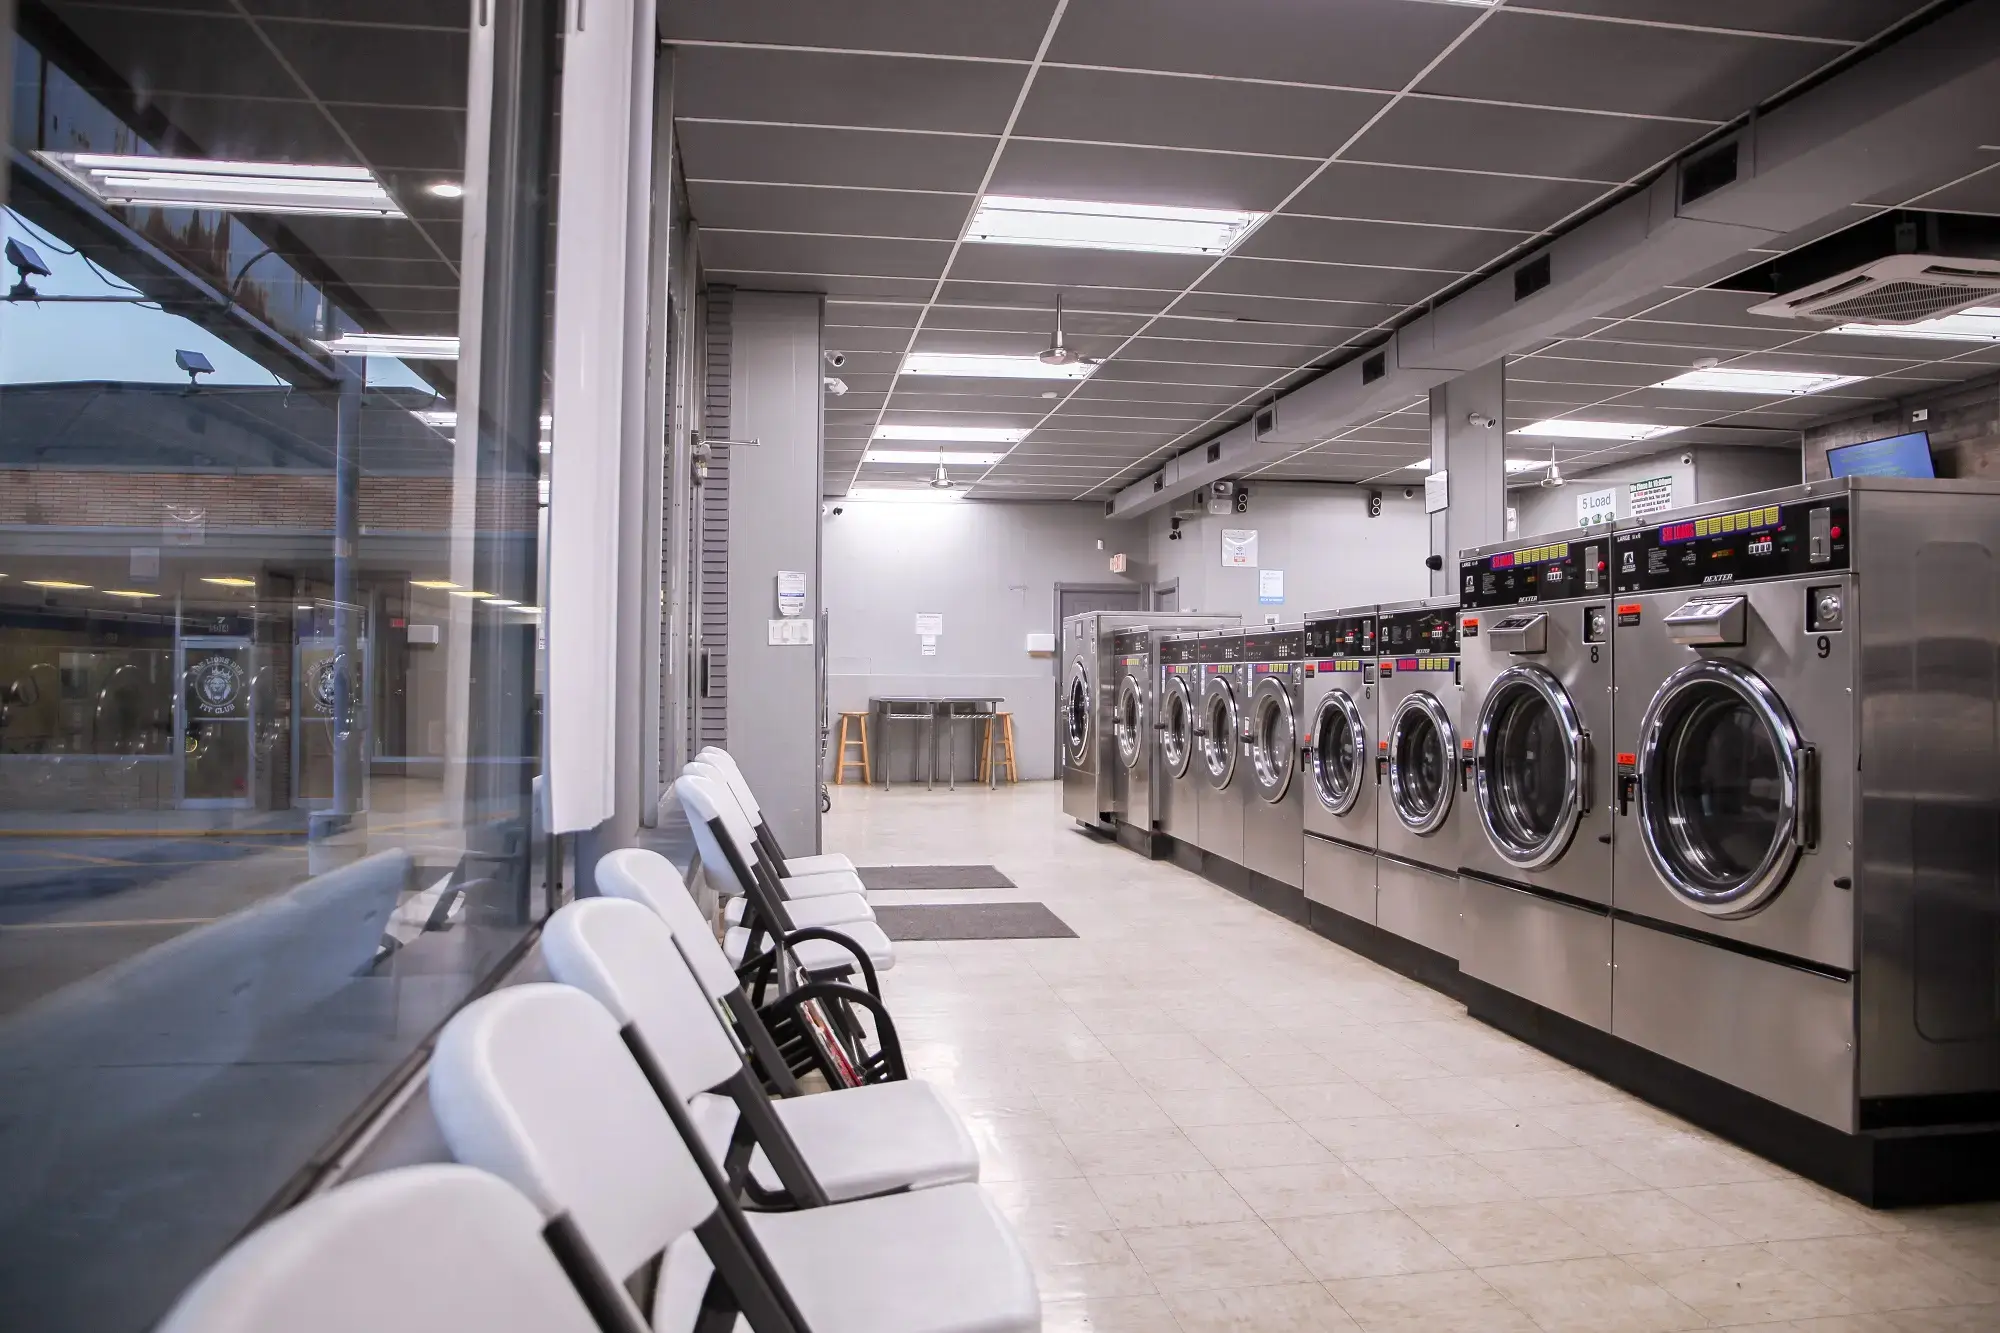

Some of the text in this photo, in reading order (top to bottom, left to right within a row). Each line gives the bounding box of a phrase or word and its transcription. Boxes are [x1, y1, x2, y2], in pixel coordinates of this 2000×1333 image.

[1582, 493, 1611, 509] 5 Load
[1703, 573, 1733, 583] DEXTER
[1816, 635, 1831, 658] 9
[205, 656, 230, 665] LIONS
[1590, 645, 1599, 664] 8
[1365, 686, 1371, 700] 6
[199, 703, 236, 714] FIT CLUB
